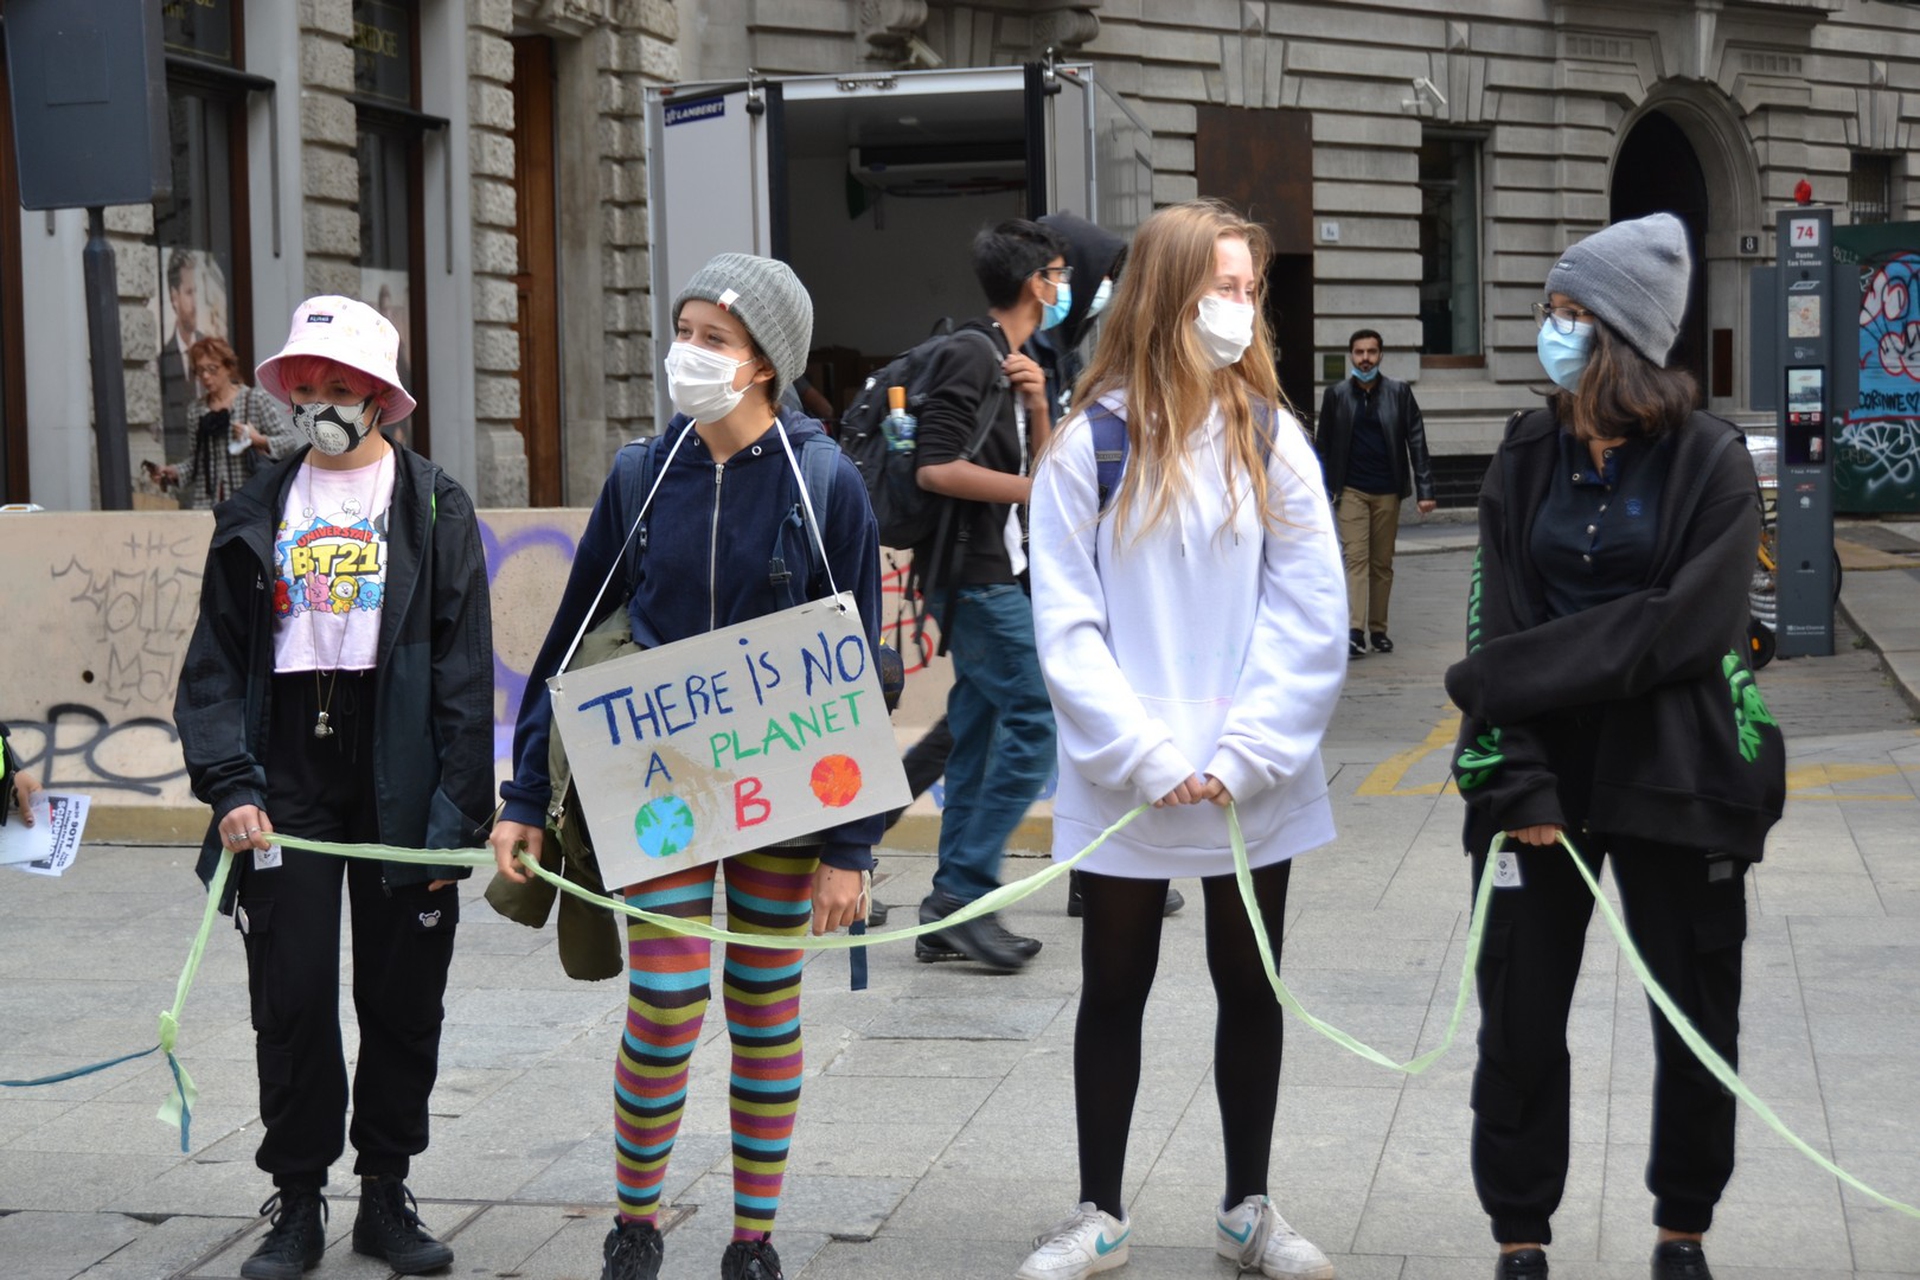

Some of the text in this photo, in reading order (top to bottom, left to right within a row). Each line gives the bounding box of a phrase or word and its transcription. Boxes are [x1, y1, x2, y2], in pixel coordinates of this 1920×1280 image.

[1746, 236, 1754, 251] 8
[1796, 226, 1814, 239] 74
[296, 525, 374, 547] UNIVERSTAR
[291, 542, 382, 579] BT21
[578, 670, 733, 745] THERE
[801, 631, 865, 696] NO
[644, 690, 865, 788] A PLANET
[733, 776, 772, 831] B
